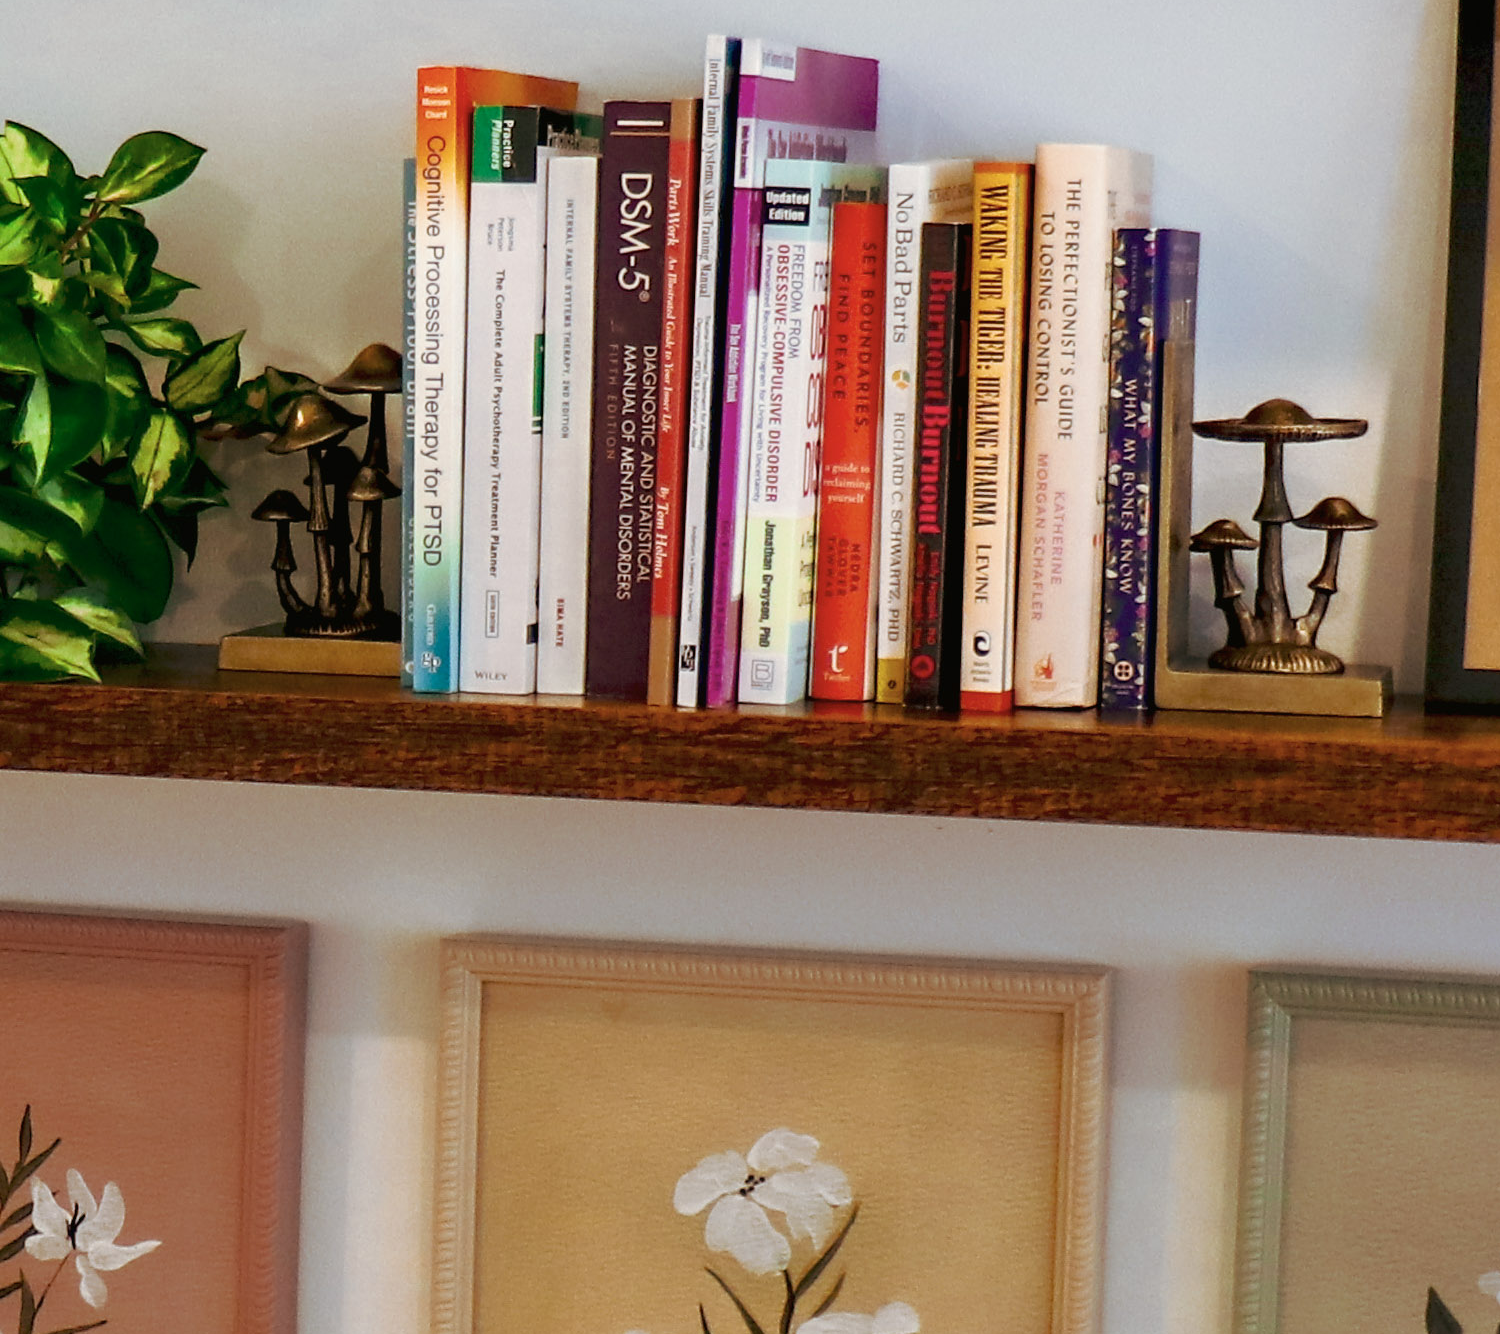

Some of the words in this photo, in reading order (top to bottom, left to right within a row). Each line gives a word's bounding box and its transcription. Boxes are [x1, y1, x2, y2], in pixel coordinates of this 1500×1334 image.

[708, 58, 721, 100] Internal
[491, 119, 502, 171] Planners
[502, 119, 515, 169] Practice
[703, 103, 720, 139] Family
[423, 135, 446, 237] Cognitive
[702, 141, 718, 186] Systems
[667, 178, 682, 212] Parts
[702, 188, 717, 217] Skills
[766, 190, 810, 205] Updated
[768, 208, 806, 222] Edition
[895, 192, 914, 224] No
[1065, 178, 1082, 212] THE
[665, 212, 681, 247] Work
[699, 219, 714, 262] Training
[979, 185, 1009, 261] WAKING
[1040, 212, 1055, 237] TO
[861, 242, 877, 277] SET
[894, 228, 913, 278] Bad
[1038, 244, 1054, 311] LOSING
[495, 269, 505, 291] The
[699, 264, 713, 298] Manual
[789, 244, 805, 313] FREEDOM
[835, 274, 850, 323] FIND
[978, 267, 1004, 301] THE
[1060, 220, 1081, 376] PERFECTIONIST'S
[421, 246, 445, 366] Processing
[493, 294, 505, 349] Complete
[563, 285, 573, 328] SYSTEMS
[892, 281, 912, 344] Parts
[767, 244, 791, 426] OBSESSIVE-COMPULSIVE
[788, 318, 802, 359] FROM
[925, 270, 956, 399] Burnout
[975, 306, 1006, 370] TIGER:
[492, 352, 504, 384] Adult
[607, 344, 619, 386] FIFTH
[621, 345, 637, 415] MANUAL
[832, 334, 848, 401] PEACE
[1034, 318, 1052, 406] CONTROL
[420, 372, 443, 462] Therapy
[641, 345, 658, 447] DIAGNOSTIC
[974, 376, 1000, 449] HEALING
[1058, 384, 1074, 441] GUIDE
[1123, 378, 1138, 429] WHAT
[490, 386, 503, 469] Psychotherapy
[606, 395, 618, 460] EDITION
[621, 420, 636, 443] OF
[891, 412, 905, 486] RICHARD
[1122, 438, 1137, 464] MY
[424, 468, 442, 497] for
[619, 447, 635, 510] MENTAL
[638, 451, 654, 489] AND
[764, 428, 782, 503] DISORDER
[823, 479, 872, 492] reclaiming
[832, 464, 858, 475] guide
[860, 464, 870, 473] to
[917, 405, 950, 534] Burnout
[971, 453, 999, 527] TRAUMA
[490, 473, 501, 532] Treatment
[656, 503, 669, 530] Tom
[657, 486, 670, 499] By
[827, 493, 866, 504] yourself
[890, 490, 903, 506] C.
[1034, 454, 1049, 530] MORGAN
[1121, 472, 1137, 531] BONES
[423, 505, 442, 566] PTSD
[490, 535, 500, 578] Planner
[616, 514, 634, 601] DISORDERS
[636, 492, 653, 583] STATISTICAL
[654, 534, 669, 579] Holmes
[763, 520, 776, 571] Jonathan
[887, 510, 902, 605] SCHWARTZ,
[1051, 491, 1065, 585] KATHERINE
[974, 544, 992, 605] LEVINE
[1031, 537, 1046, 621] SCHAFLER
[1119, 538, 1134, 594] KNOW
[758, 573, 774, 623] Grayson,
[758, 626, 771, 648] PhD
[887, 608, 900, 642] PHD
[474, 669, 508, 681] WILEY
